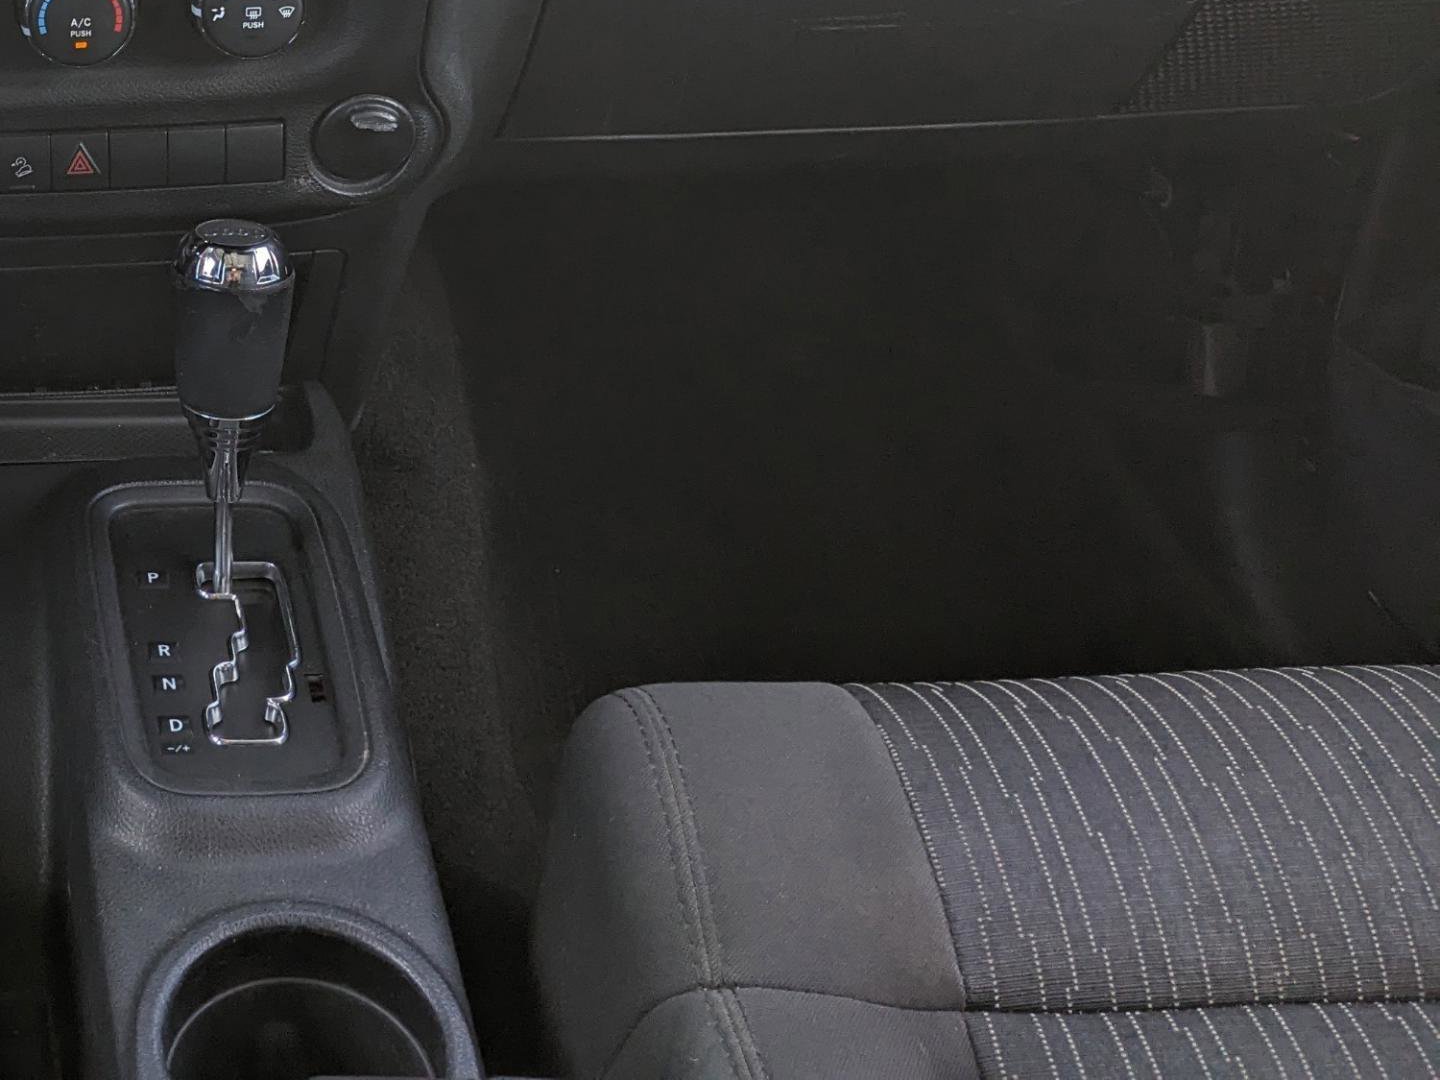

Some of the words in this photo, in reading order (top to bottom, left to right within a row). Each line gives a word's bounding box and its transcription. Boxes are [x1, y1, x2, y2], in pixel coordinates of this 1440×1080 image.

[70, 17, 91, 28] A/C
[147, 572, 159, 583] P
[158, 645, 170, 657] R
[162, 678, 176, 690] N
[169, 719, 183, 732] D
